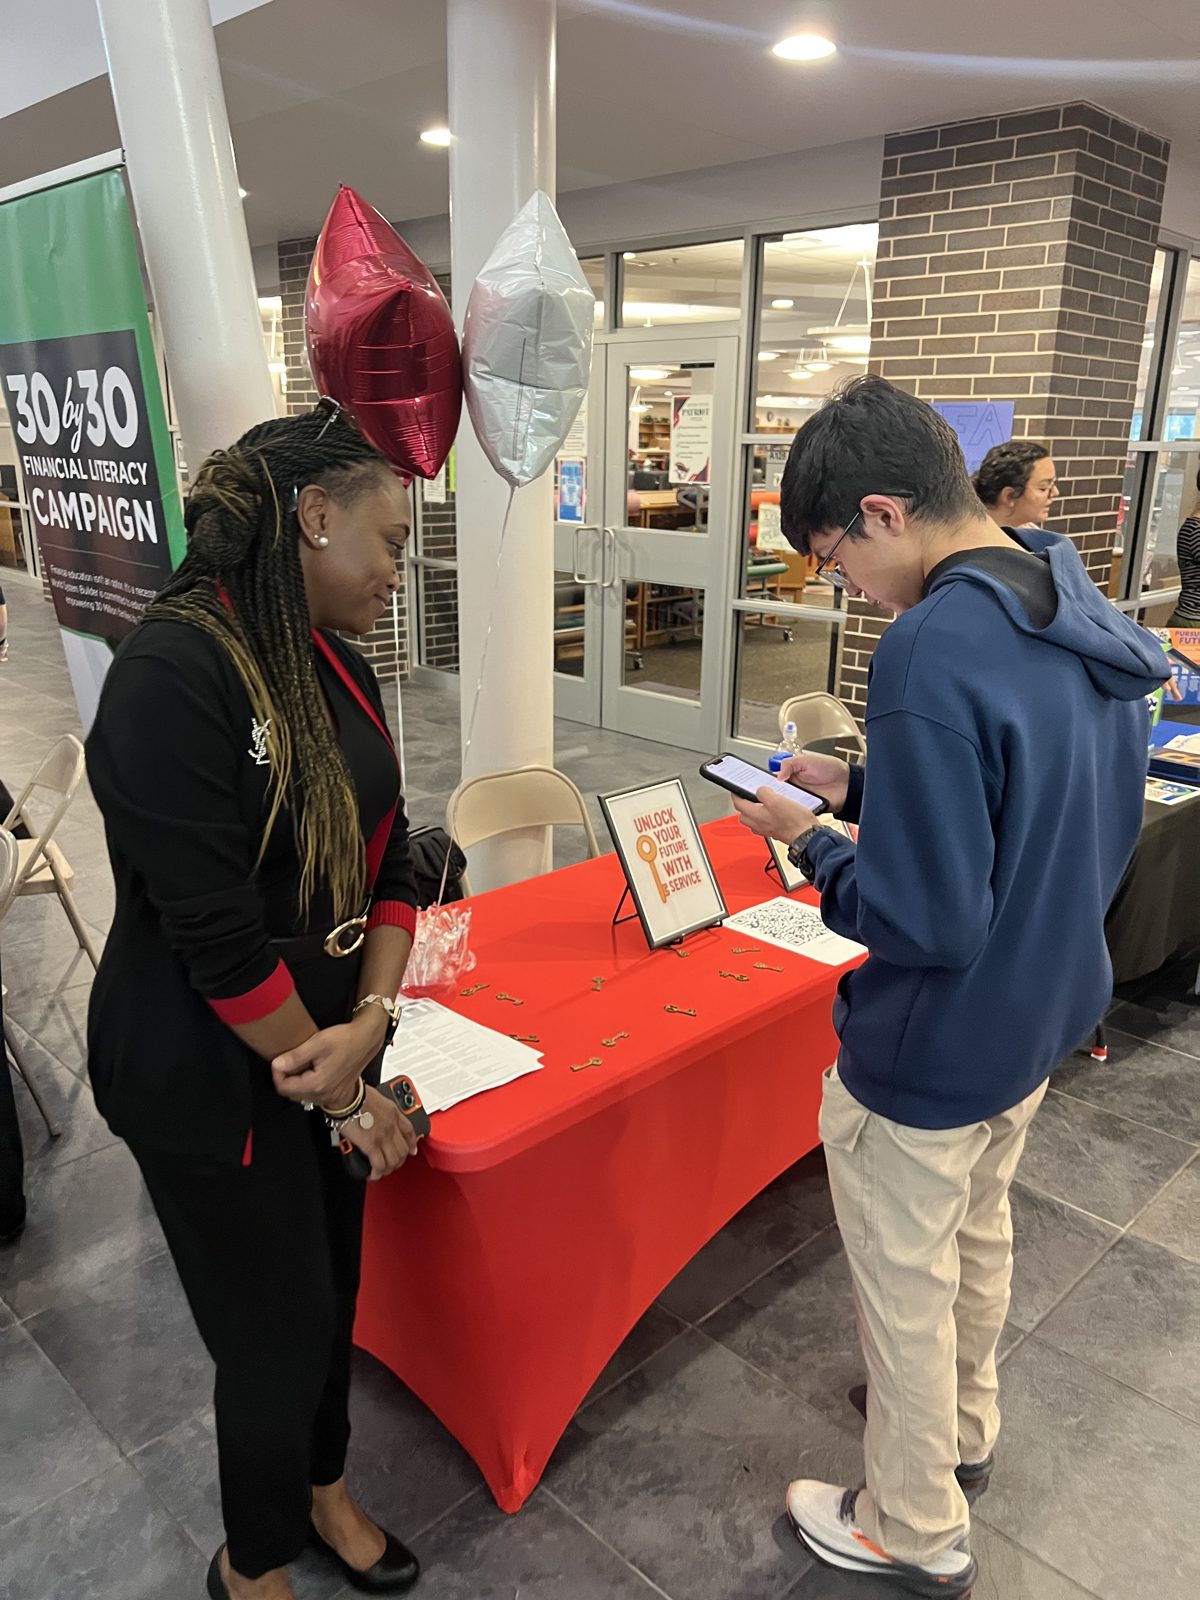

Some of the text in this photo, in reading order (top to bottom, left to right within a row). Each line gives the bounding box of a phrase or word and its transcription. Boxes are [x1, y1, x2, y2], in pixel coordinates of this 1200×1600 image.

[6, 366, 138, 454] 30 by 30
[935, 404, 1005, 446] FA
[22, 455, 148, 486] FINANCIAL LITERACY
[32, 487, 158, 544] CAMPAIGN
[634, 808, 676, 833] UNLOCK
[653, 825, 682, 845] YOUR
[659, 839, 689, 859] FUTURE
[662, 854, 693, 877] WITH
[668, 871, 701, 893] SERVICE
